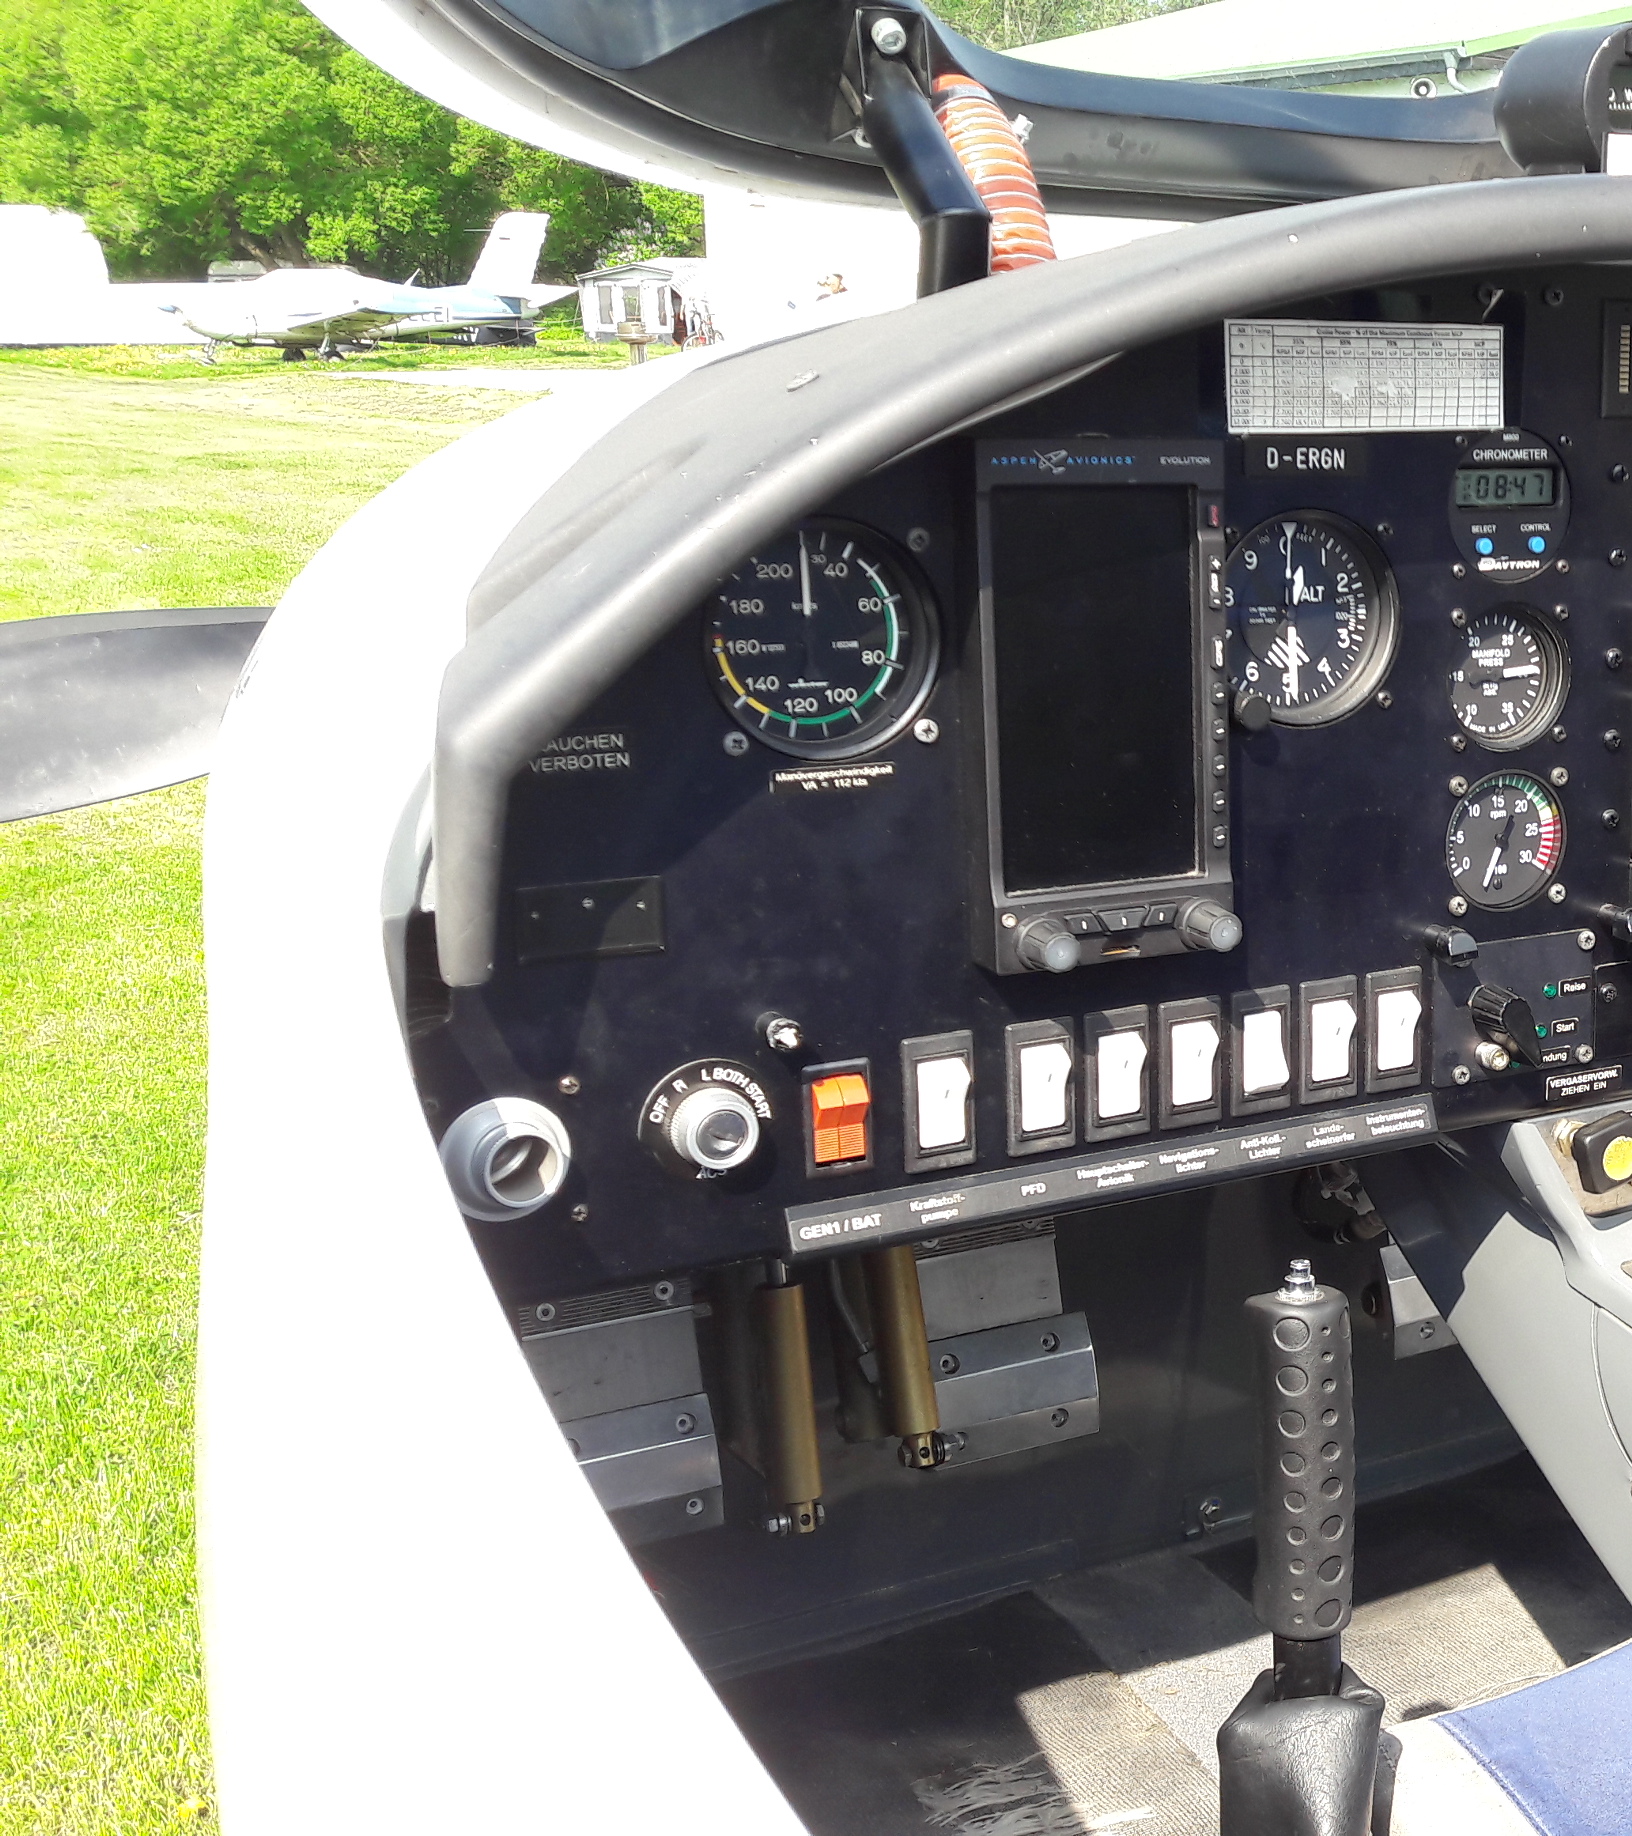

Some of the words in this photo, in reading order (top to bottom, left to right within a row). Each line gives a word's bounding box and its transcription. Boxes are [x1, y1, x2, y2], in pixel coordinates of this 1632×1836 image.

[991, 456, 1037, 465] ASPEN
[1066, 456, 1133, 465] AVIONICS
[1160, 456, 1211, 466] EVOLUTION
[1266, 447, 1346, 470] D-ERGN
[1473, 449, 1548, 460] CHRONOMETER
[810, 554, 826, 564] 30
[1244, 549, 1258, 570] 9
[756, 563, 793, 580] 200
[824, 562, 848, 577] 40
[1336, 572, 1350, 593] 2
[1301, 586, 1325, 602] ALT
[729, 598, 765, 614] 180
[858, 598, 882, 613] 60
[1337, 628, 1350, 649] 3
[1468, 637, 1480, 648] 20
[1502, 634, 1514, 646] 25
[727, 639, 760, 655] 160
[1472, 648, 1511, 658] MANIFOLD
[861, 650, 885, 666] 80
[1245, 661, 1259, 681] 6
[746, 676, 780, 691] 140
[825, 688, 857, 704] 100
[784, 698, 818, 714] 120
[1465, 704, 1477, 715] 10
[1502, 702, 1514, 713] 35
[541, 733, 625, 752] AUCHEN
[528, 752, 631, 773] VERBOTEN
[801, 780, 818, 791] VA
[833, 778, 851, 788] 112
[1491, 795, 1504, 807] 15
[1514, 799, 1528, 813] 20
[1467, 805, 1481, 817] 10
[1490, 809, 1507, 820] rpm
[1525, 823, 1539, 836] 25
[1456, 831, 1464, 844] 5
[1519, 850, 1532, 864] 30
[1563, 981, 1586, 992] Reise
[1555, 1021, 1575, 1033] Start
[1543, 1051, 1567, 1062] ndung
[701, 1068, 712, 1081] L
[713, 1067, 750, 1088] BOTH
[1550, 1068, 1619, 1088] VERGASERVORW.
[672, 1079, 689, 1094] R
[1561, 1083, 1590, 1096] ZIEHEN
[745, 1082, 773, 1119] START
[649, 1094, 669, 1124] OFF
[1366, 1108, 1426, 1126] Instrumenten-
[1312, 1123, 1345, 1136] Lande-
[1370, 1119, 1425, 1136] beleuchtung
[1158, 1147, 1220, 1165] Navigations-
[1248, 1145, 1281, 1160] Lichter
[1076, 1160, 1149, 1180] Hauptschalter-
[1175, 1160, 1207, 1174] lichter
[1020, 1182, 1046, 1197] PFD
[909, 1193, 966, 1212] Kraftstoff-
[920, 1207, 959, 1224] pumpe
[799, 1224, 841, 1240] GEN1
[852, 1213, 882, 1231] BAT
